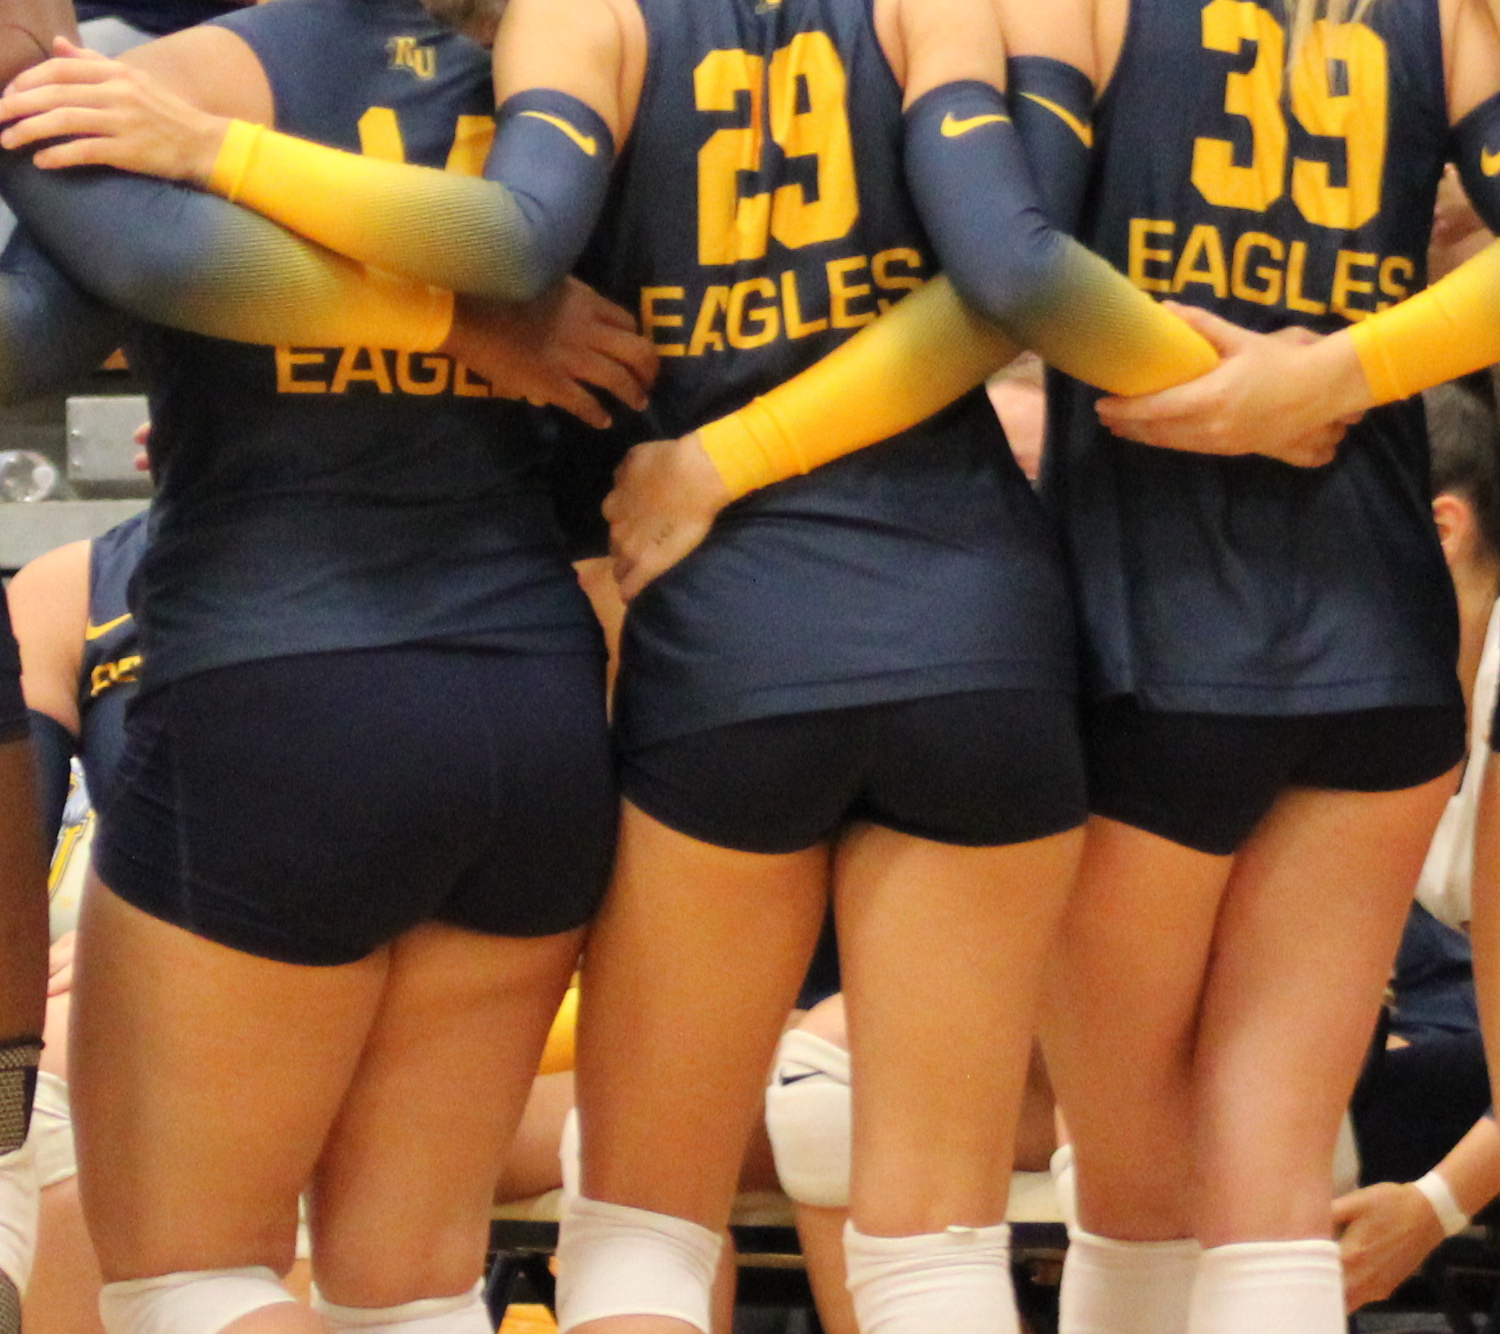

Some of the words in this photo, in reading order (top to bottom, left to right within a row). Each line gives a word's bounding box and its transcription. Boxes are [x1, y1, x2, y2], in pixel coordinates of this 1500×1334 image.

[693, 30, 860, 267] 29
[641, 246, 930, 357] EAGLES
[1128, 218, 1415, 324] EAGLES
